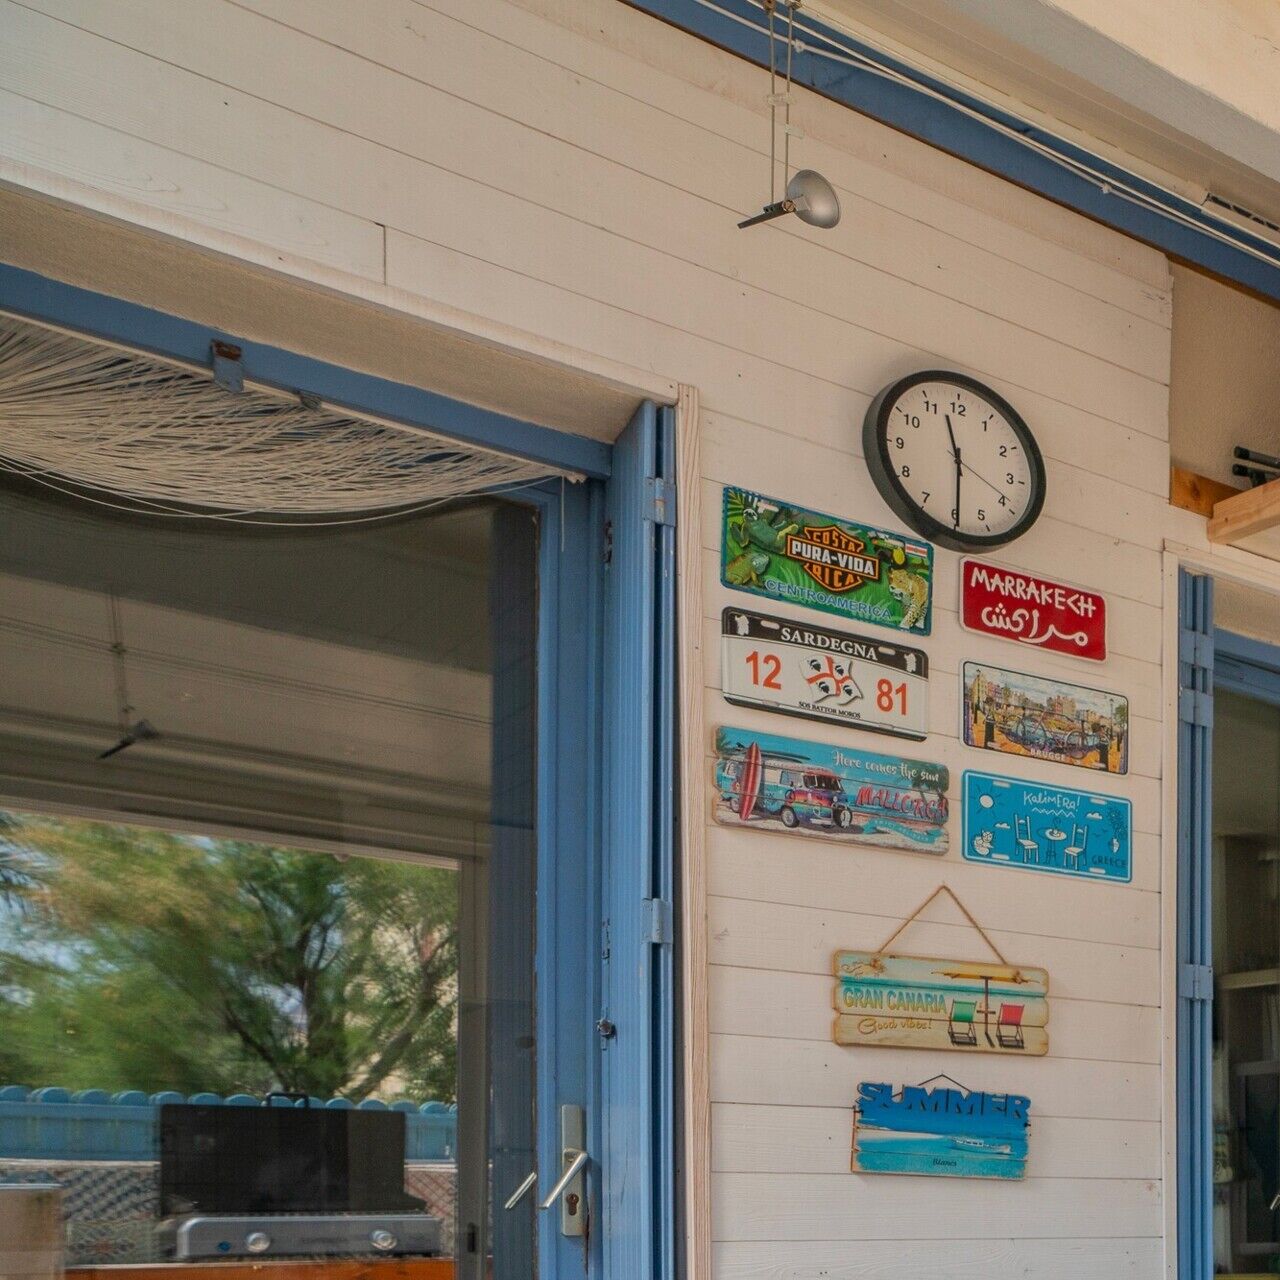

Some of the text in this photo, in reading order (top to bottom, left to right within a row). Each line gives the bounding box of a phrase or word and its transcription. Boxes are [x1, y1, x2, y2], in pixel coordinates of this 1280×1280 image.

[923, 400, 938, 414] 11
[950, 402, 966, 417] 12
[903, 413, 920, 429] 10
[981, 420, 988, 432] 1
[895, 437, 904, 449] 9
[999, 445, 1007, 457] 2
[901, 465, 910, 478] 8
[1006, 473, 1014, 485] 3
[921, 491, 930, 503] 7
[998, 495, 1006, 507] 4
[977, 509, 985, 521] 5
[812, 530, 855, 552] COSTA
[791, 540, 875, 576] PURA-VIDA
[812, 564, 855, 587] RICA
[764, 579, 892, 619] CENTROAMERICA
[970, 567, 1096, 618] MARRAKECH
[780, 627, 878, 661] SARDEGNA
[745, 651, 782, 690] 12
[876, 678, 907, 716] 81
[1030, 749, 1066, 761] BRUGGE
[832, 750, 939, 783] Here comes the sun
[856, 784, 949, 820] MALLORCA
[1091, 855, 1127, 867] GREECE
[843, 987, 947, 1014] GRAN CANARIA
[857, 1017, 932, 1035] Good vibes!
[855, 1081, 1031, 1119] SUMMER
